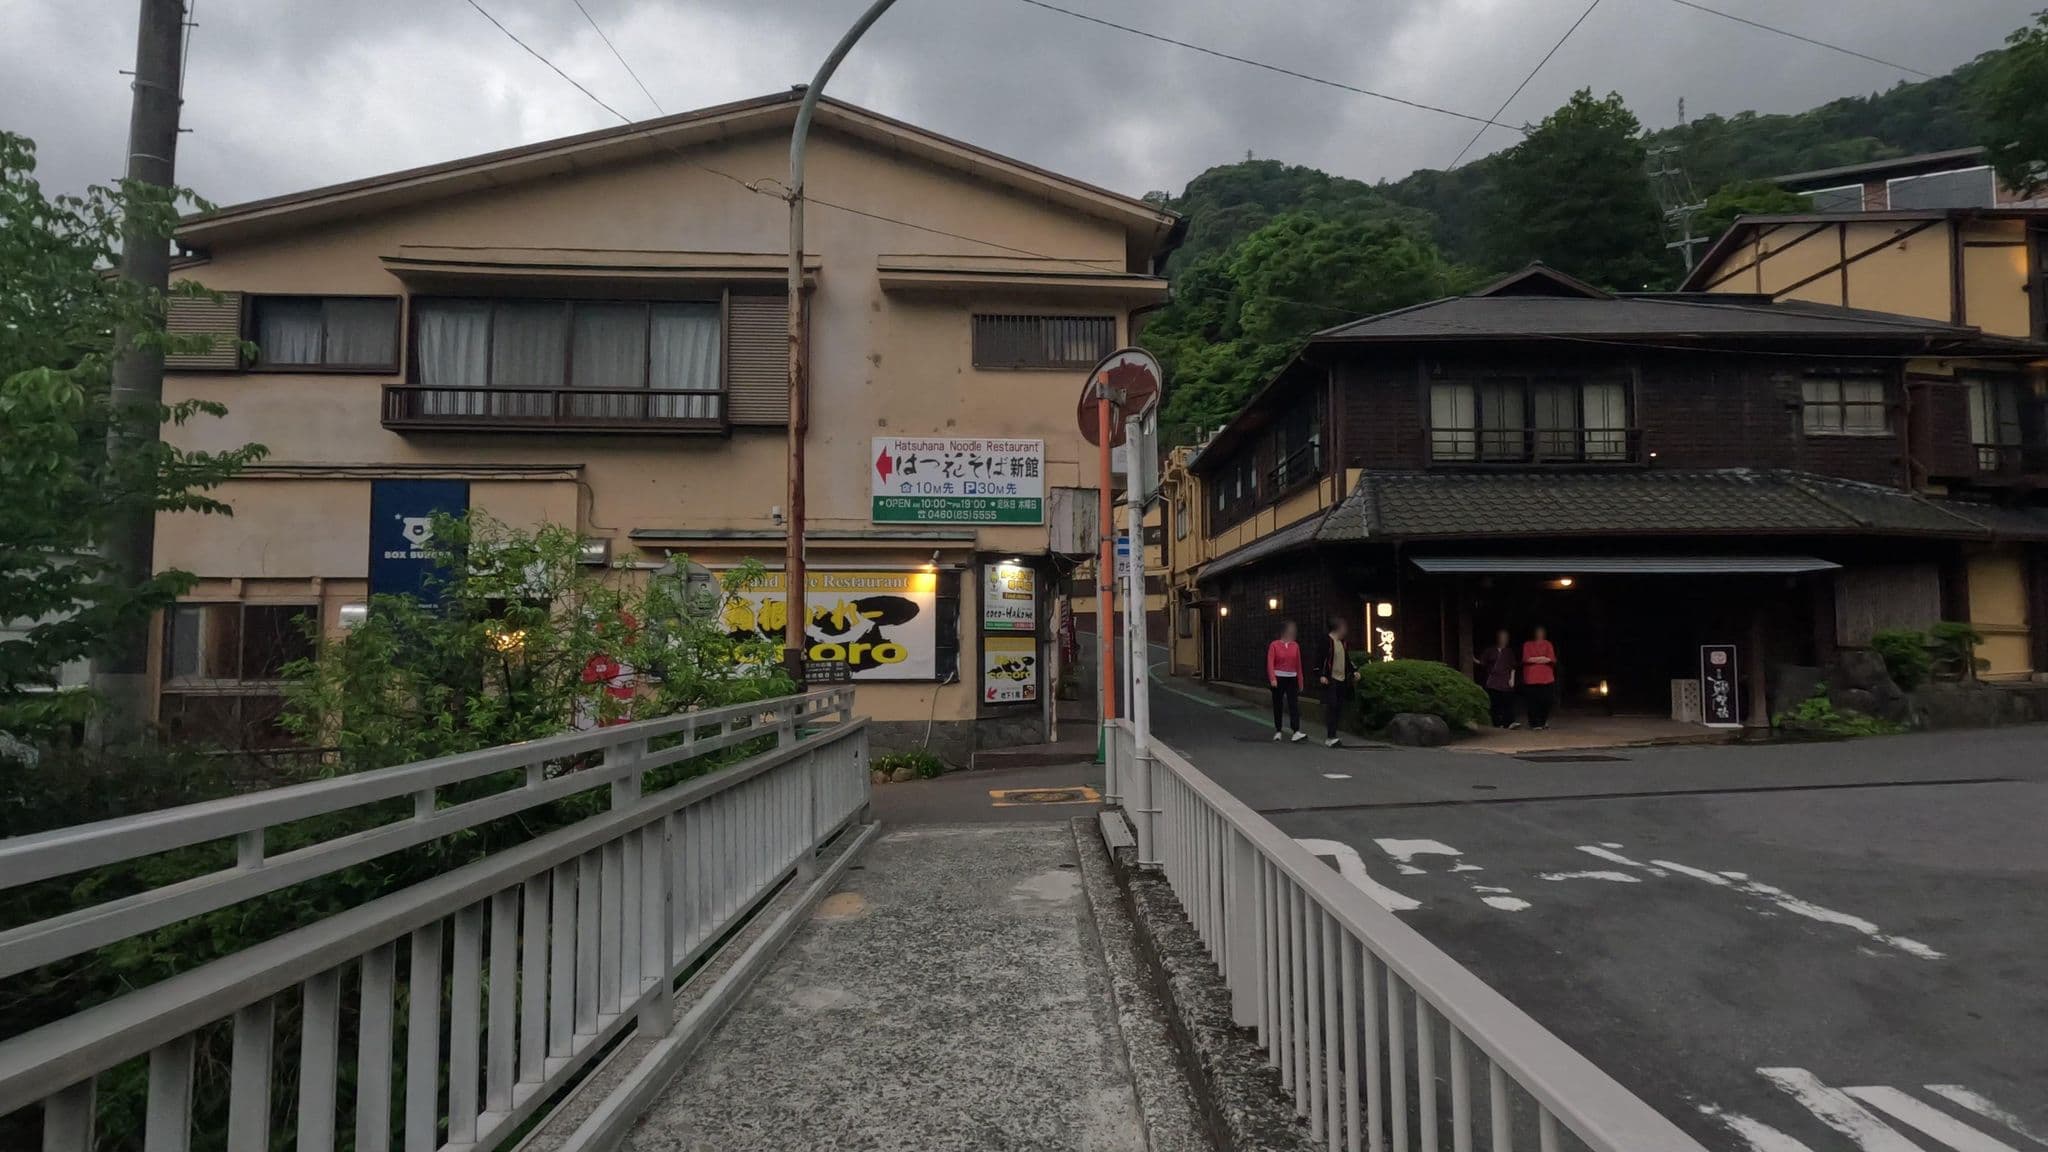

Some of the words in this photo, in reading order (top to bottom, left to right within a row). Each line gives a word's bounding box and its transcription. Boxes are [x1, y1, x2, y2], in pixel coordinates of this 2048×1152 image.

[895, 440, 945, 451] Hatsuhana
[950, 441, 982, 452] Noodle
[986, 441, 1039, 452] Restaurant
[885, 499, 911, 508] OPEN
[384, 551, 406, 559] BOX
[823, 575, 909, 588] Restaurant
